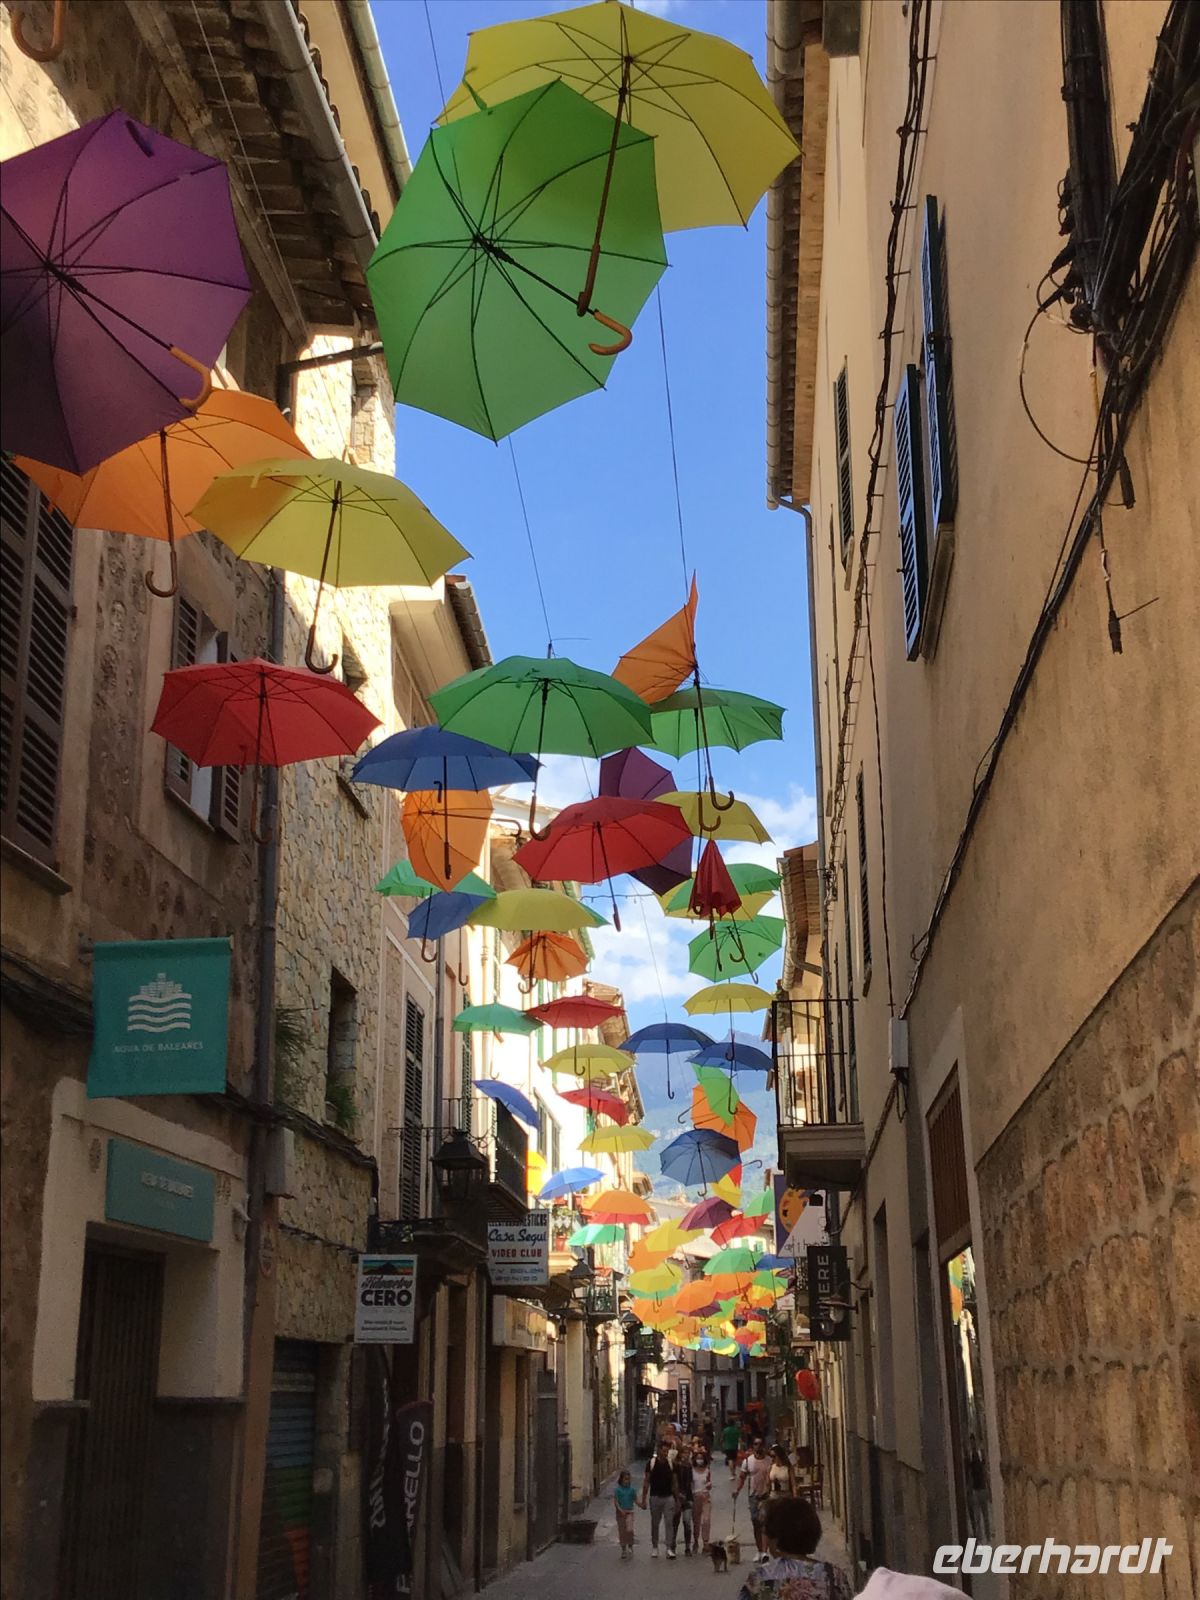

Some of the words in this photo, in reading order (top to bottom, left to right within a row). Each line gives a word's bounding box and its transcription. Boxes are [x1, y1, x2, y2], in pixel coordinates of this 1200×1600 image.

[489, 1228, 515, 1242] Casa
[491, 1248, 517, 1257] VIDEO
[520, 1248, 542, 1257] CLUB
[361, 1289, 412, 1306] CERO
